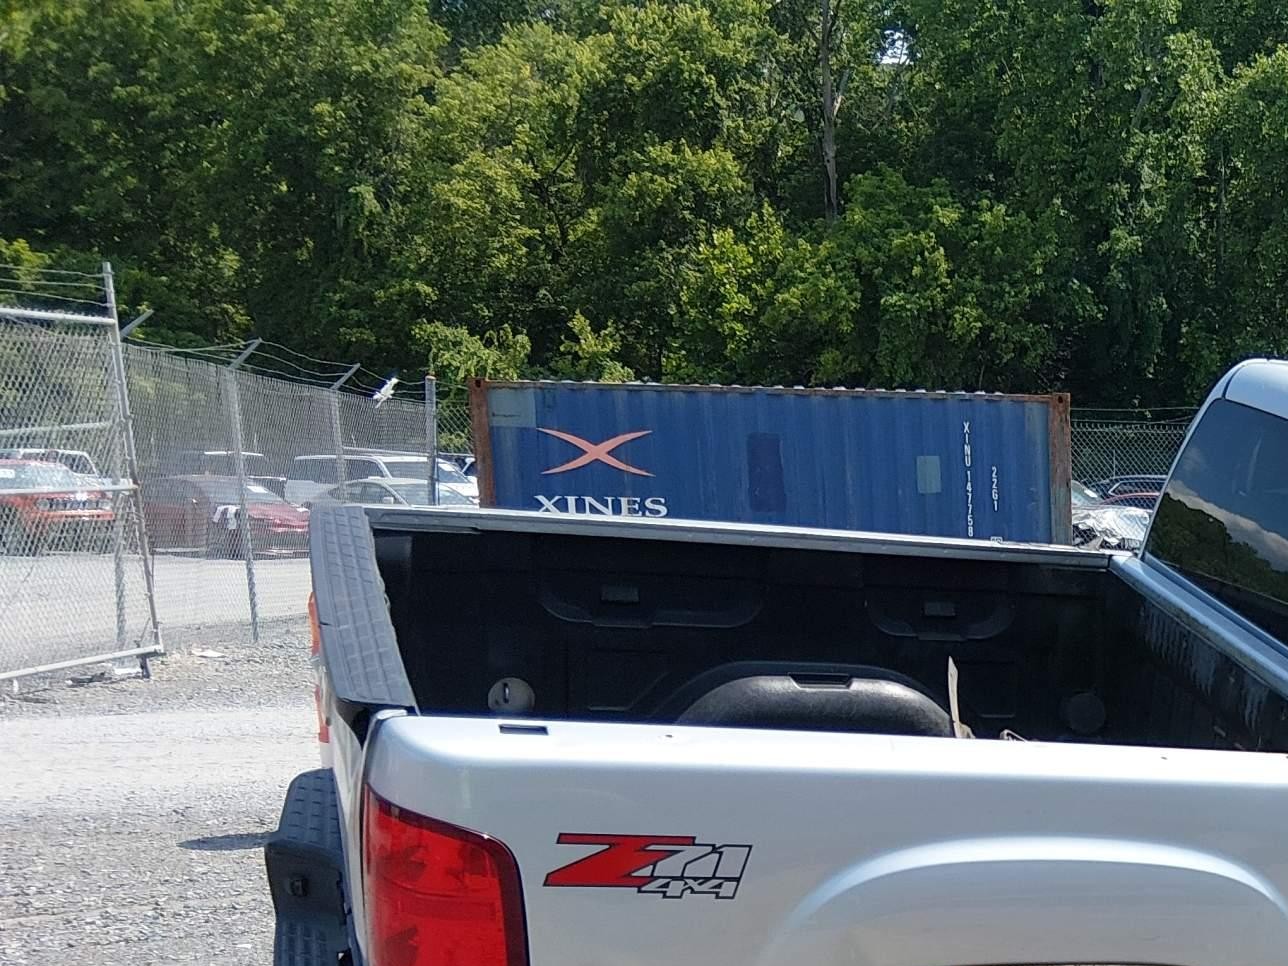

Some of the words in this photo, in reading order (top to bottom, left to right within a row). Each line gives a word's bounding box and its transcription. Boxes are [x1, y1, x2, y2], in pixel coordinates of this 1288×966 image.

[963, 421, 972, 467] XINU
[534, 495, 668, 517] XINES
[966, 470, 974, 537] 147758
[543, 832, 752, 888] Z71
